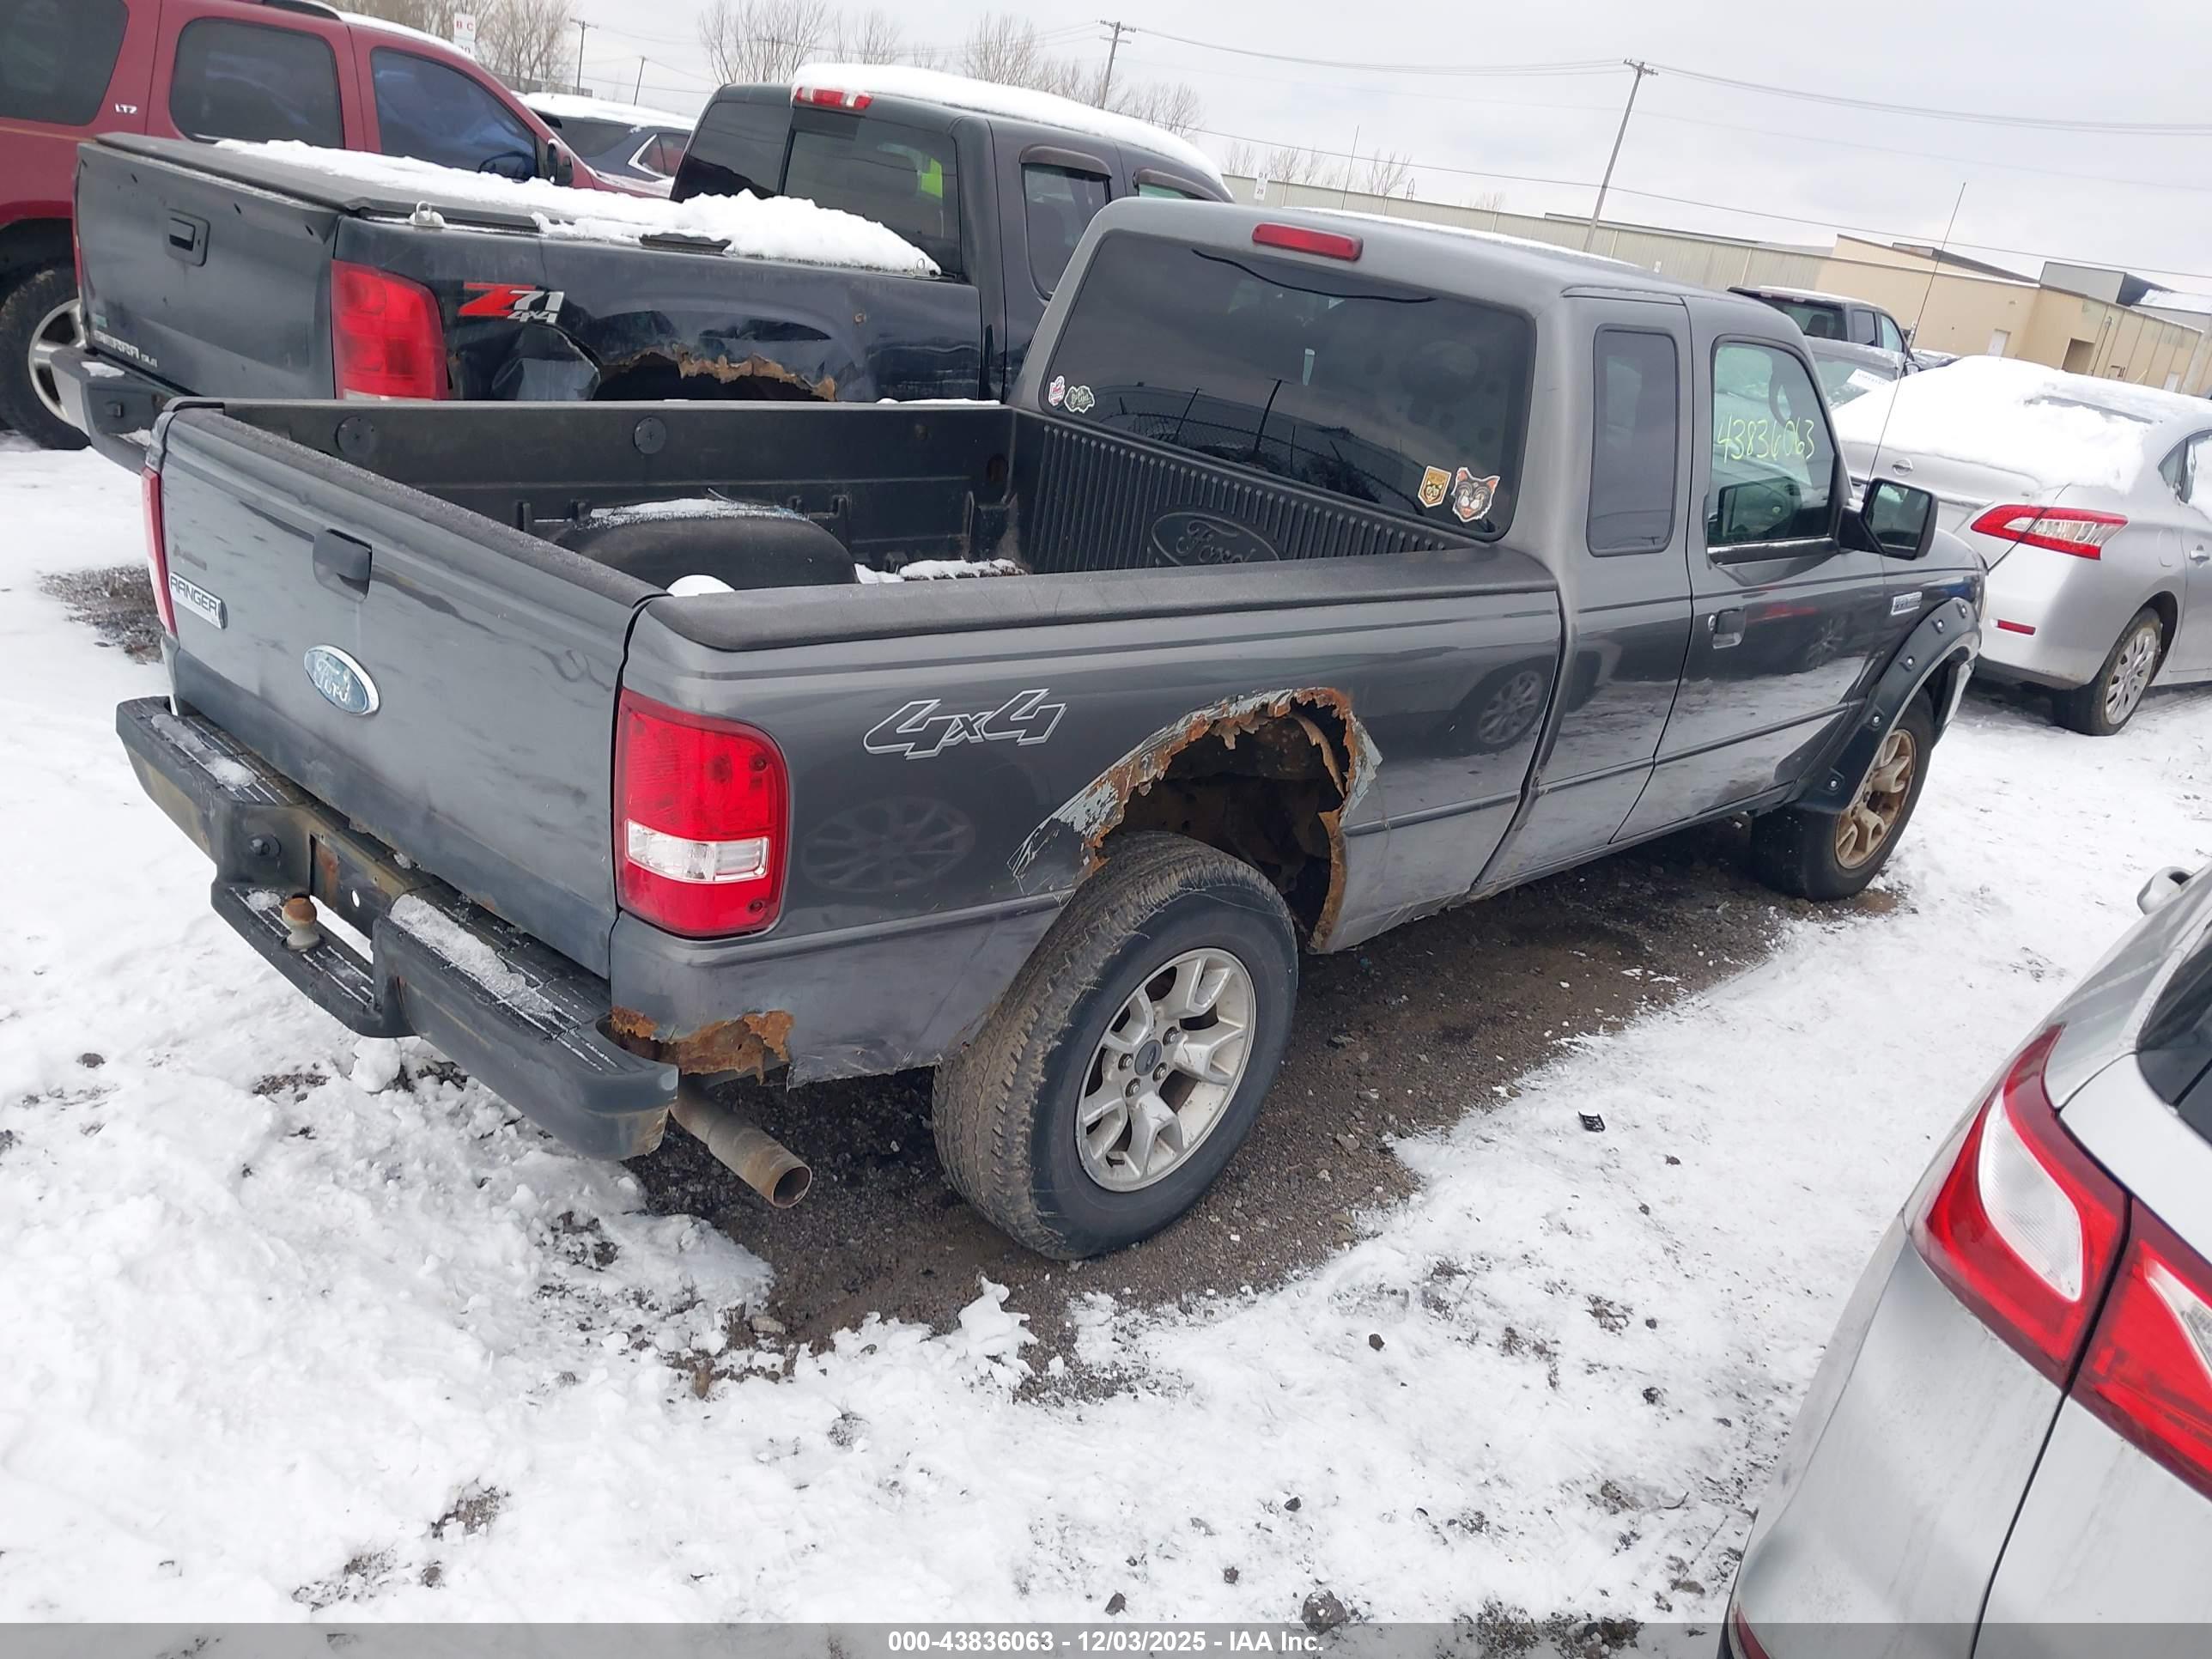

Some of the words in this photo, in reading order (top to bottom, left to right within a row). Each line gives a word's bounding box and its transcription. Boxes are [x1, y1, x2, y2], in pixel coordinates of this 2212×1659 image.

[114, 102, 138, 114] LTZ
[458, 281, 565, 317] Z71
[1717, 413, 1815, 464] 43836063
[170, 574, 218, 617] RANGER
[313, 656, 352, 705] Ford
[863, 688, 1067, 760] 4x4
